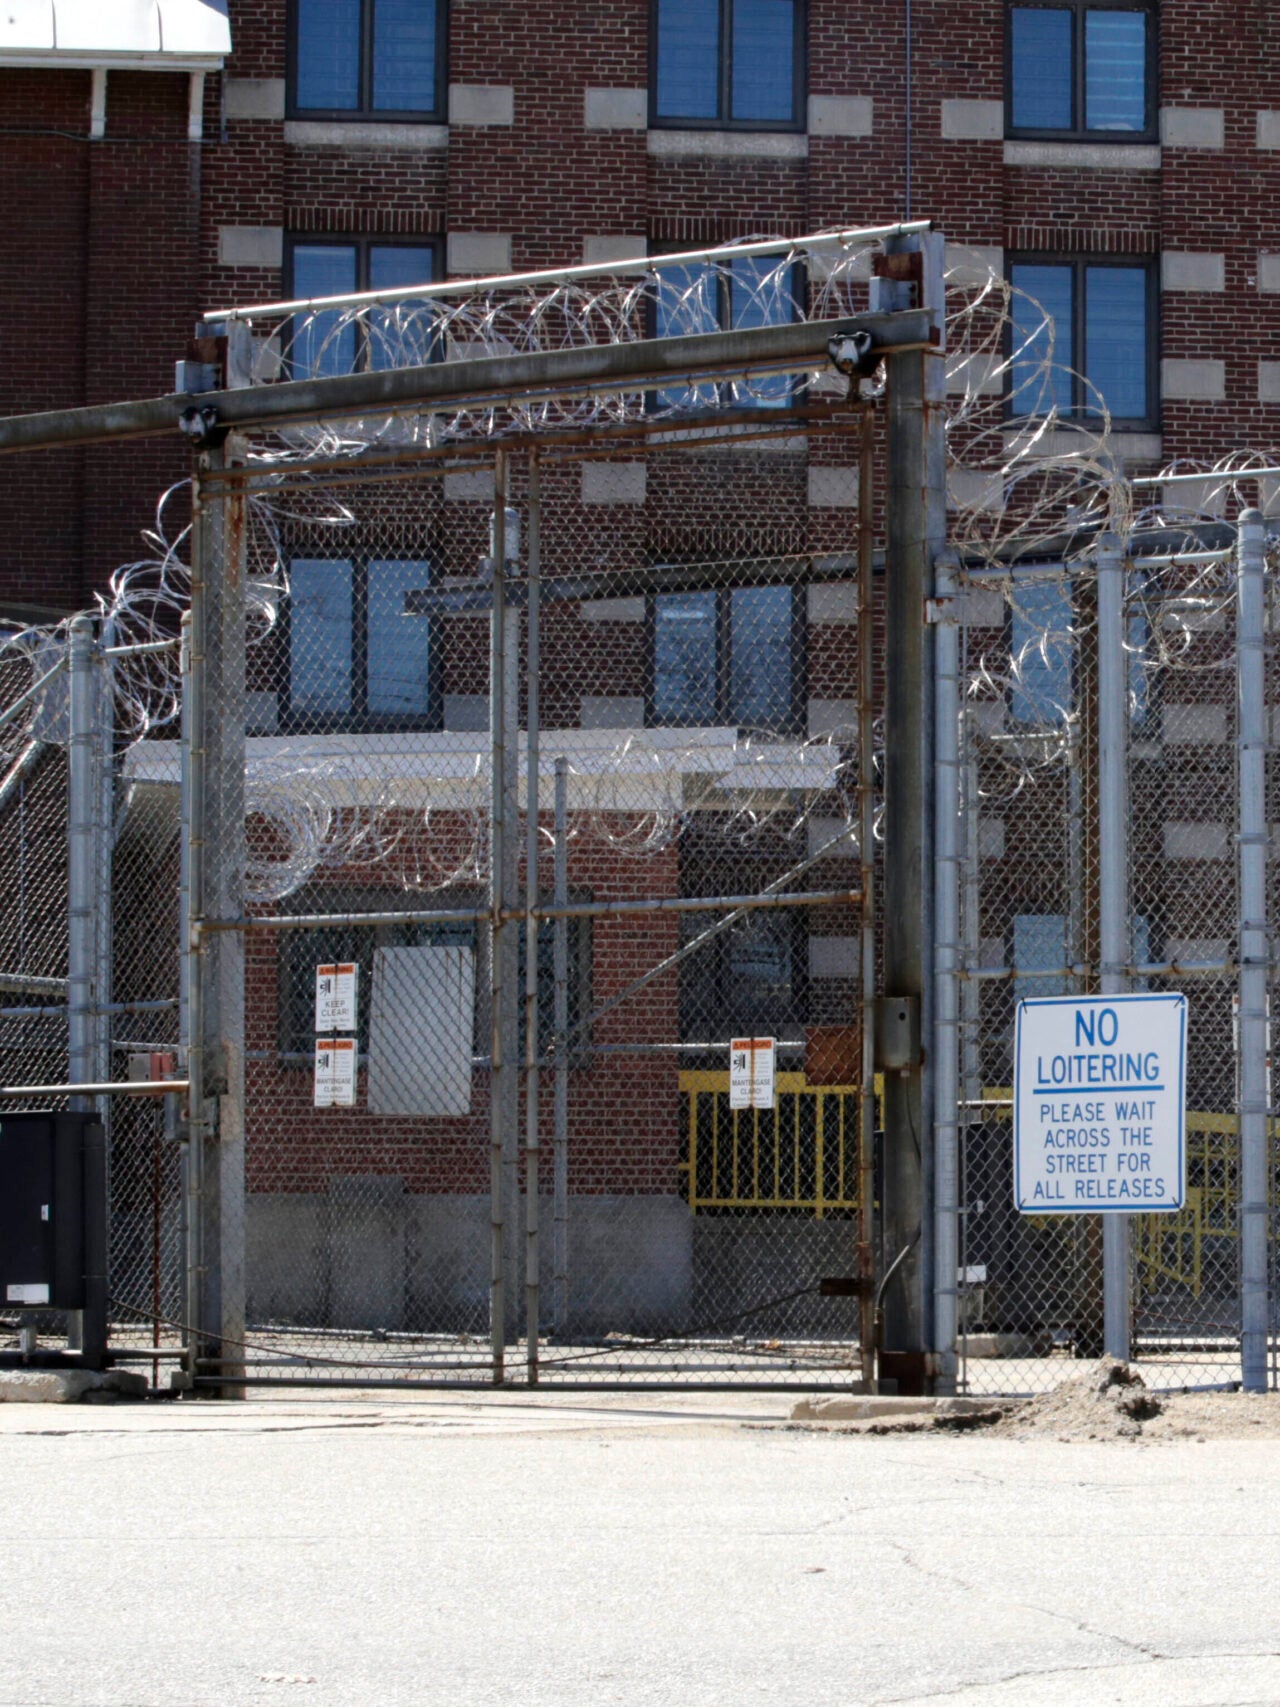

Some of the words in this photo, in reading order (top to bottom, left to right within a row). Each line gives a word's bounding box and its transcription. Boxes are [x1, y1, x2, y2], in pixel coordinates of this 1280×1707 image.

[325, 1000, 345, 1008] KEEP
[1075, 1008, 1119, 1047] NO
[1037, 1052, 1160, 1084] LOITERING
[732, 1079, 771, 1087] MANTEGASE
[1040, 1102, 1105, 1123] PLEASE
[1115, 1101, 1156, 1121] WAIT
[1044, 1128, 1110, 1149] ACROSS
[1120, 1127, 1153, 1146] THE
[1045, 1154, 1107, 1174] STREET
[1117, 1153, 1151, 1172] FOR
[1033, 1181, 1065, 1199] ALL
[1075, 1178, 1165, 1198] RELEASES
